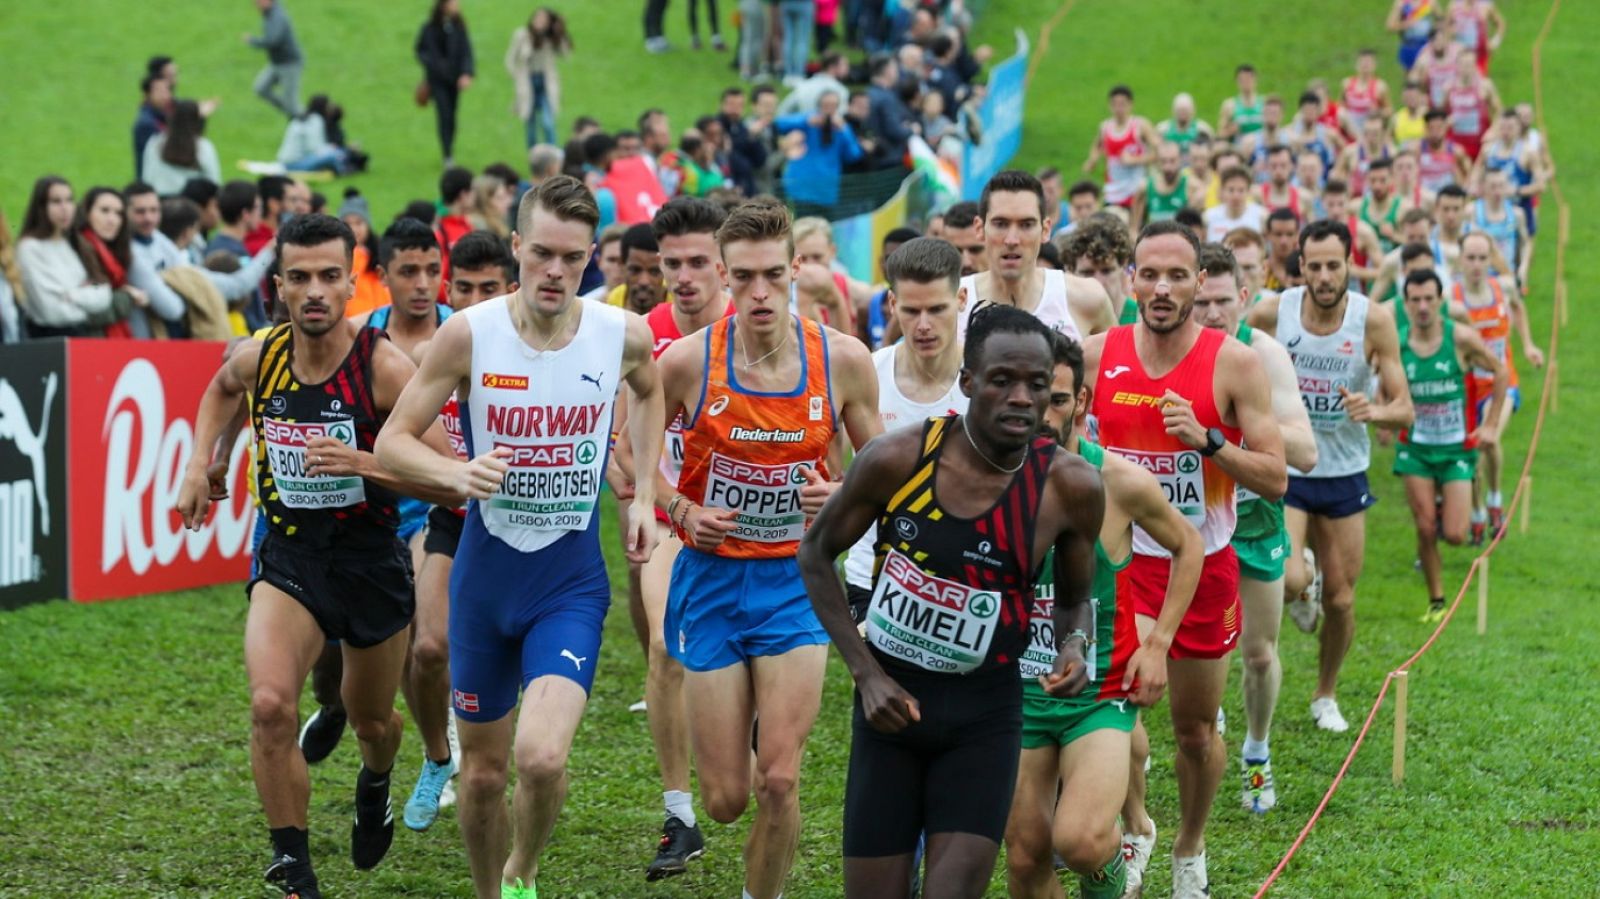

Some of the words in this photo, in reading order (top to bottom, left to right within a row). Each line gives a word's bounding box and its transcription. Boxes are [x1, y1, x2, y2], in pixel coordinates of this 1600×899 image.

[499, 378, 527, 387] EXTRA
[1302, 394, 1345, 412] ABZ
[487, 402, 606, 438] NORWAY
[713, 458, 787, 485] SPAR
[496, 468, 598, 499] NGEBRIGTSEN
[321, 493, 347, 504] 2019
[517, 502, 541, 513] RUN
[542, 503, 575, 514] CLEAN
[508, 513, 552, 527] LISBOA
[554, 514, 583, 526] 2019
[751, 517, 784, 527] CLEAN
[763, 528, 789, 539] 2019
[888, 555, 967, 608] SPAR
[878, 581, 987, 652] KIMELI
[878, 634, 925, 663] LISBOA
[925, 656, 959, 672] 2019
[889, 626, 914, 643] RUN
[914, 634, 955, 658] CLEAN
